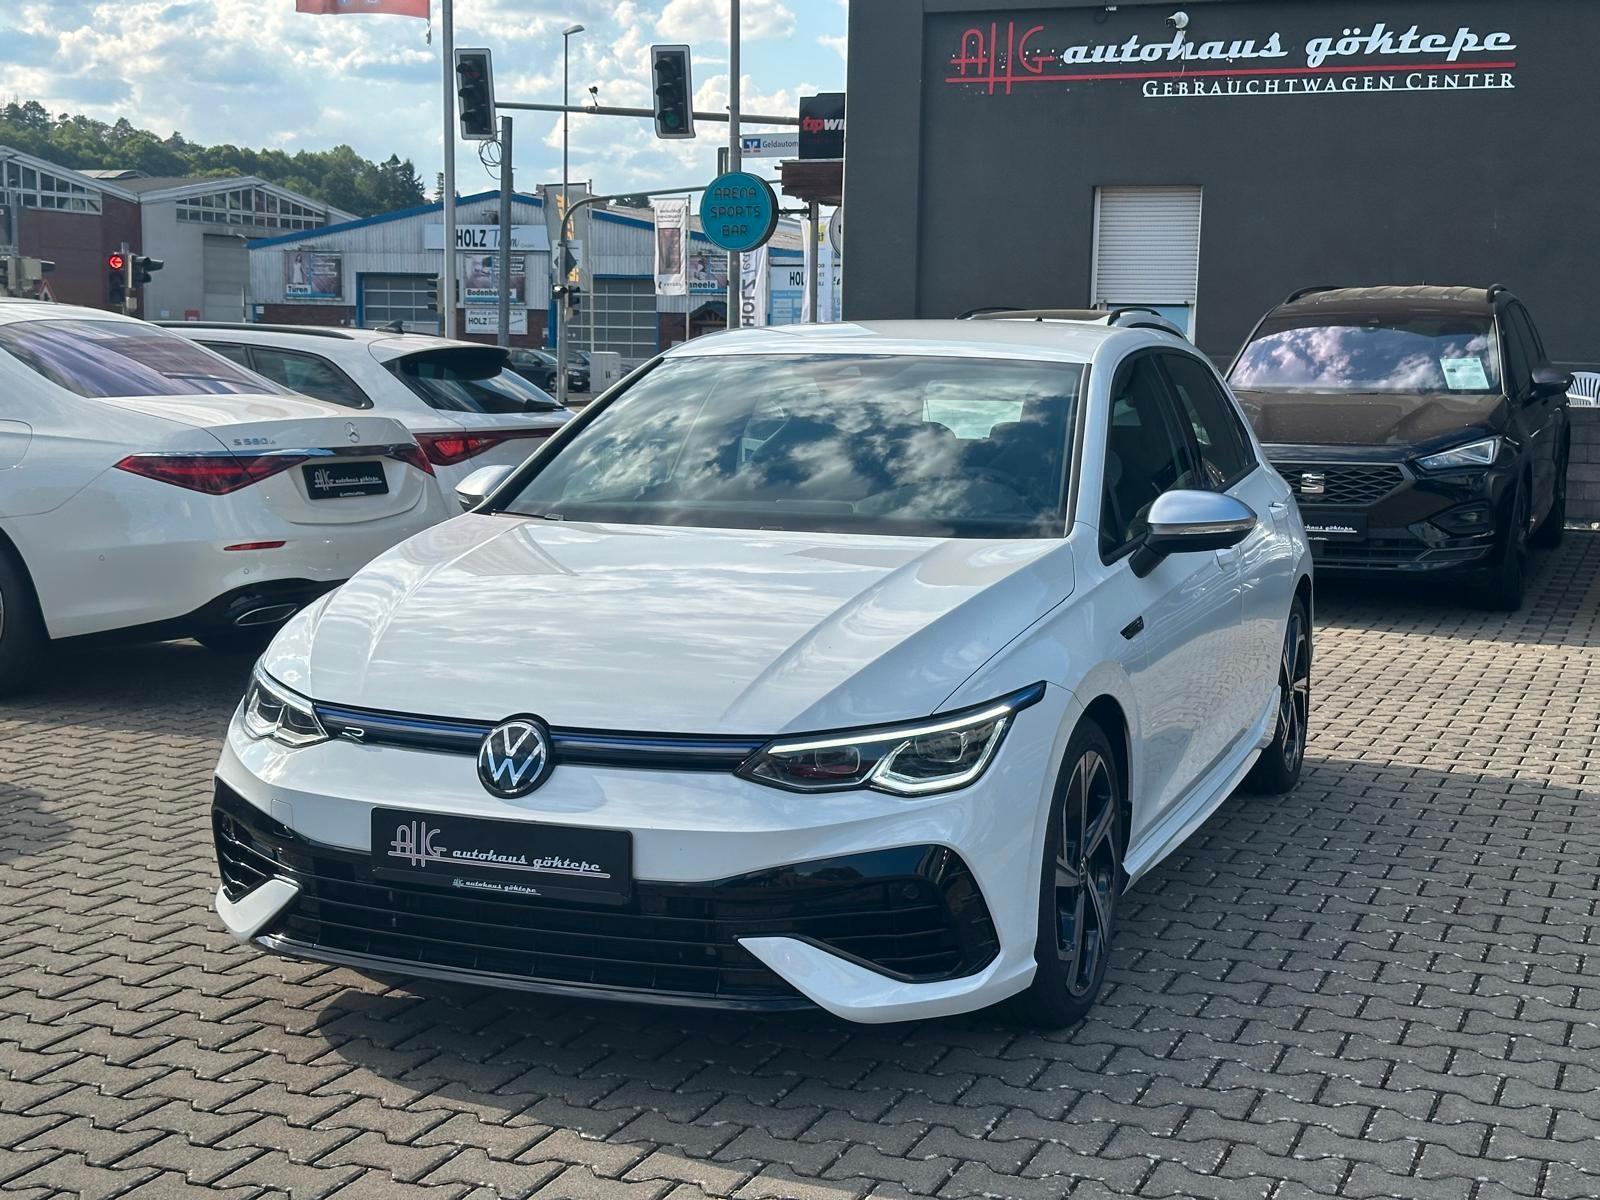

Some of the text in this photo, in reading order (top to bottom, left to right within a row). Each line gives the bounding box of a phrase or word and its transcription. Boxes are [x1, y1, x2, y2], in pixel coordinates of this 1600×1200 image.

[1063, 31, 1289, 64] autohaus
[1305, 23, 1518, 69] göktepe
[714, 186, 757, 199] ARENA
[710, 205, 761, 218] SPORTS
[455, 229, 487, 248] HOLZ
[721, 224, 748, 237] BAR
[452, 848, 528, 865] autohaus
[532, 856, 601, 874] göktepe
